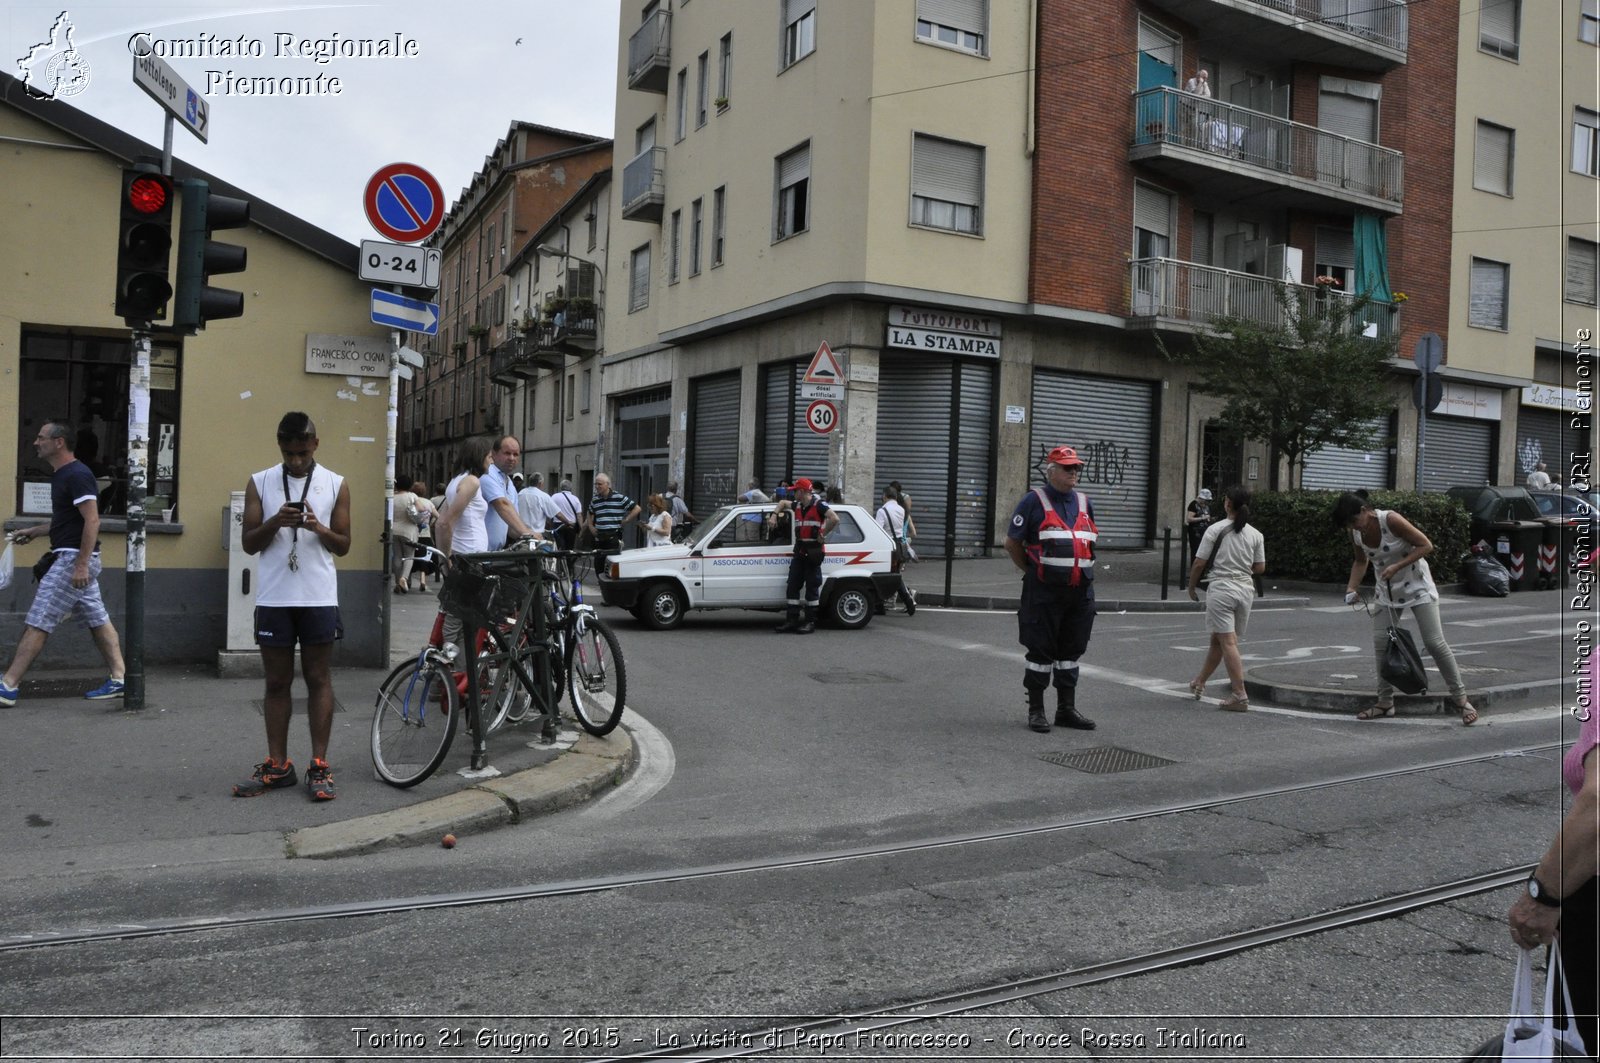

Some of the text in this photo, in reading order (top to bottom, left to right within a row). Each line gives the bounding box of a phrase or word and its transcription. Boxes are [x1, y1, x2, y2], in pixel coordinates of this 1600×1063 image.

[139, 48, 177, 100] Cottolengo
[368, 253, 417, 273] 0-24
[893, 330, 997, 355] LA STAMPA
[311, 348, 386, 363] FRANCESCO CIGNA
[814, 408, 832, 425] 30
[713, 558, 763, 566] ASSOCIAZIONE
